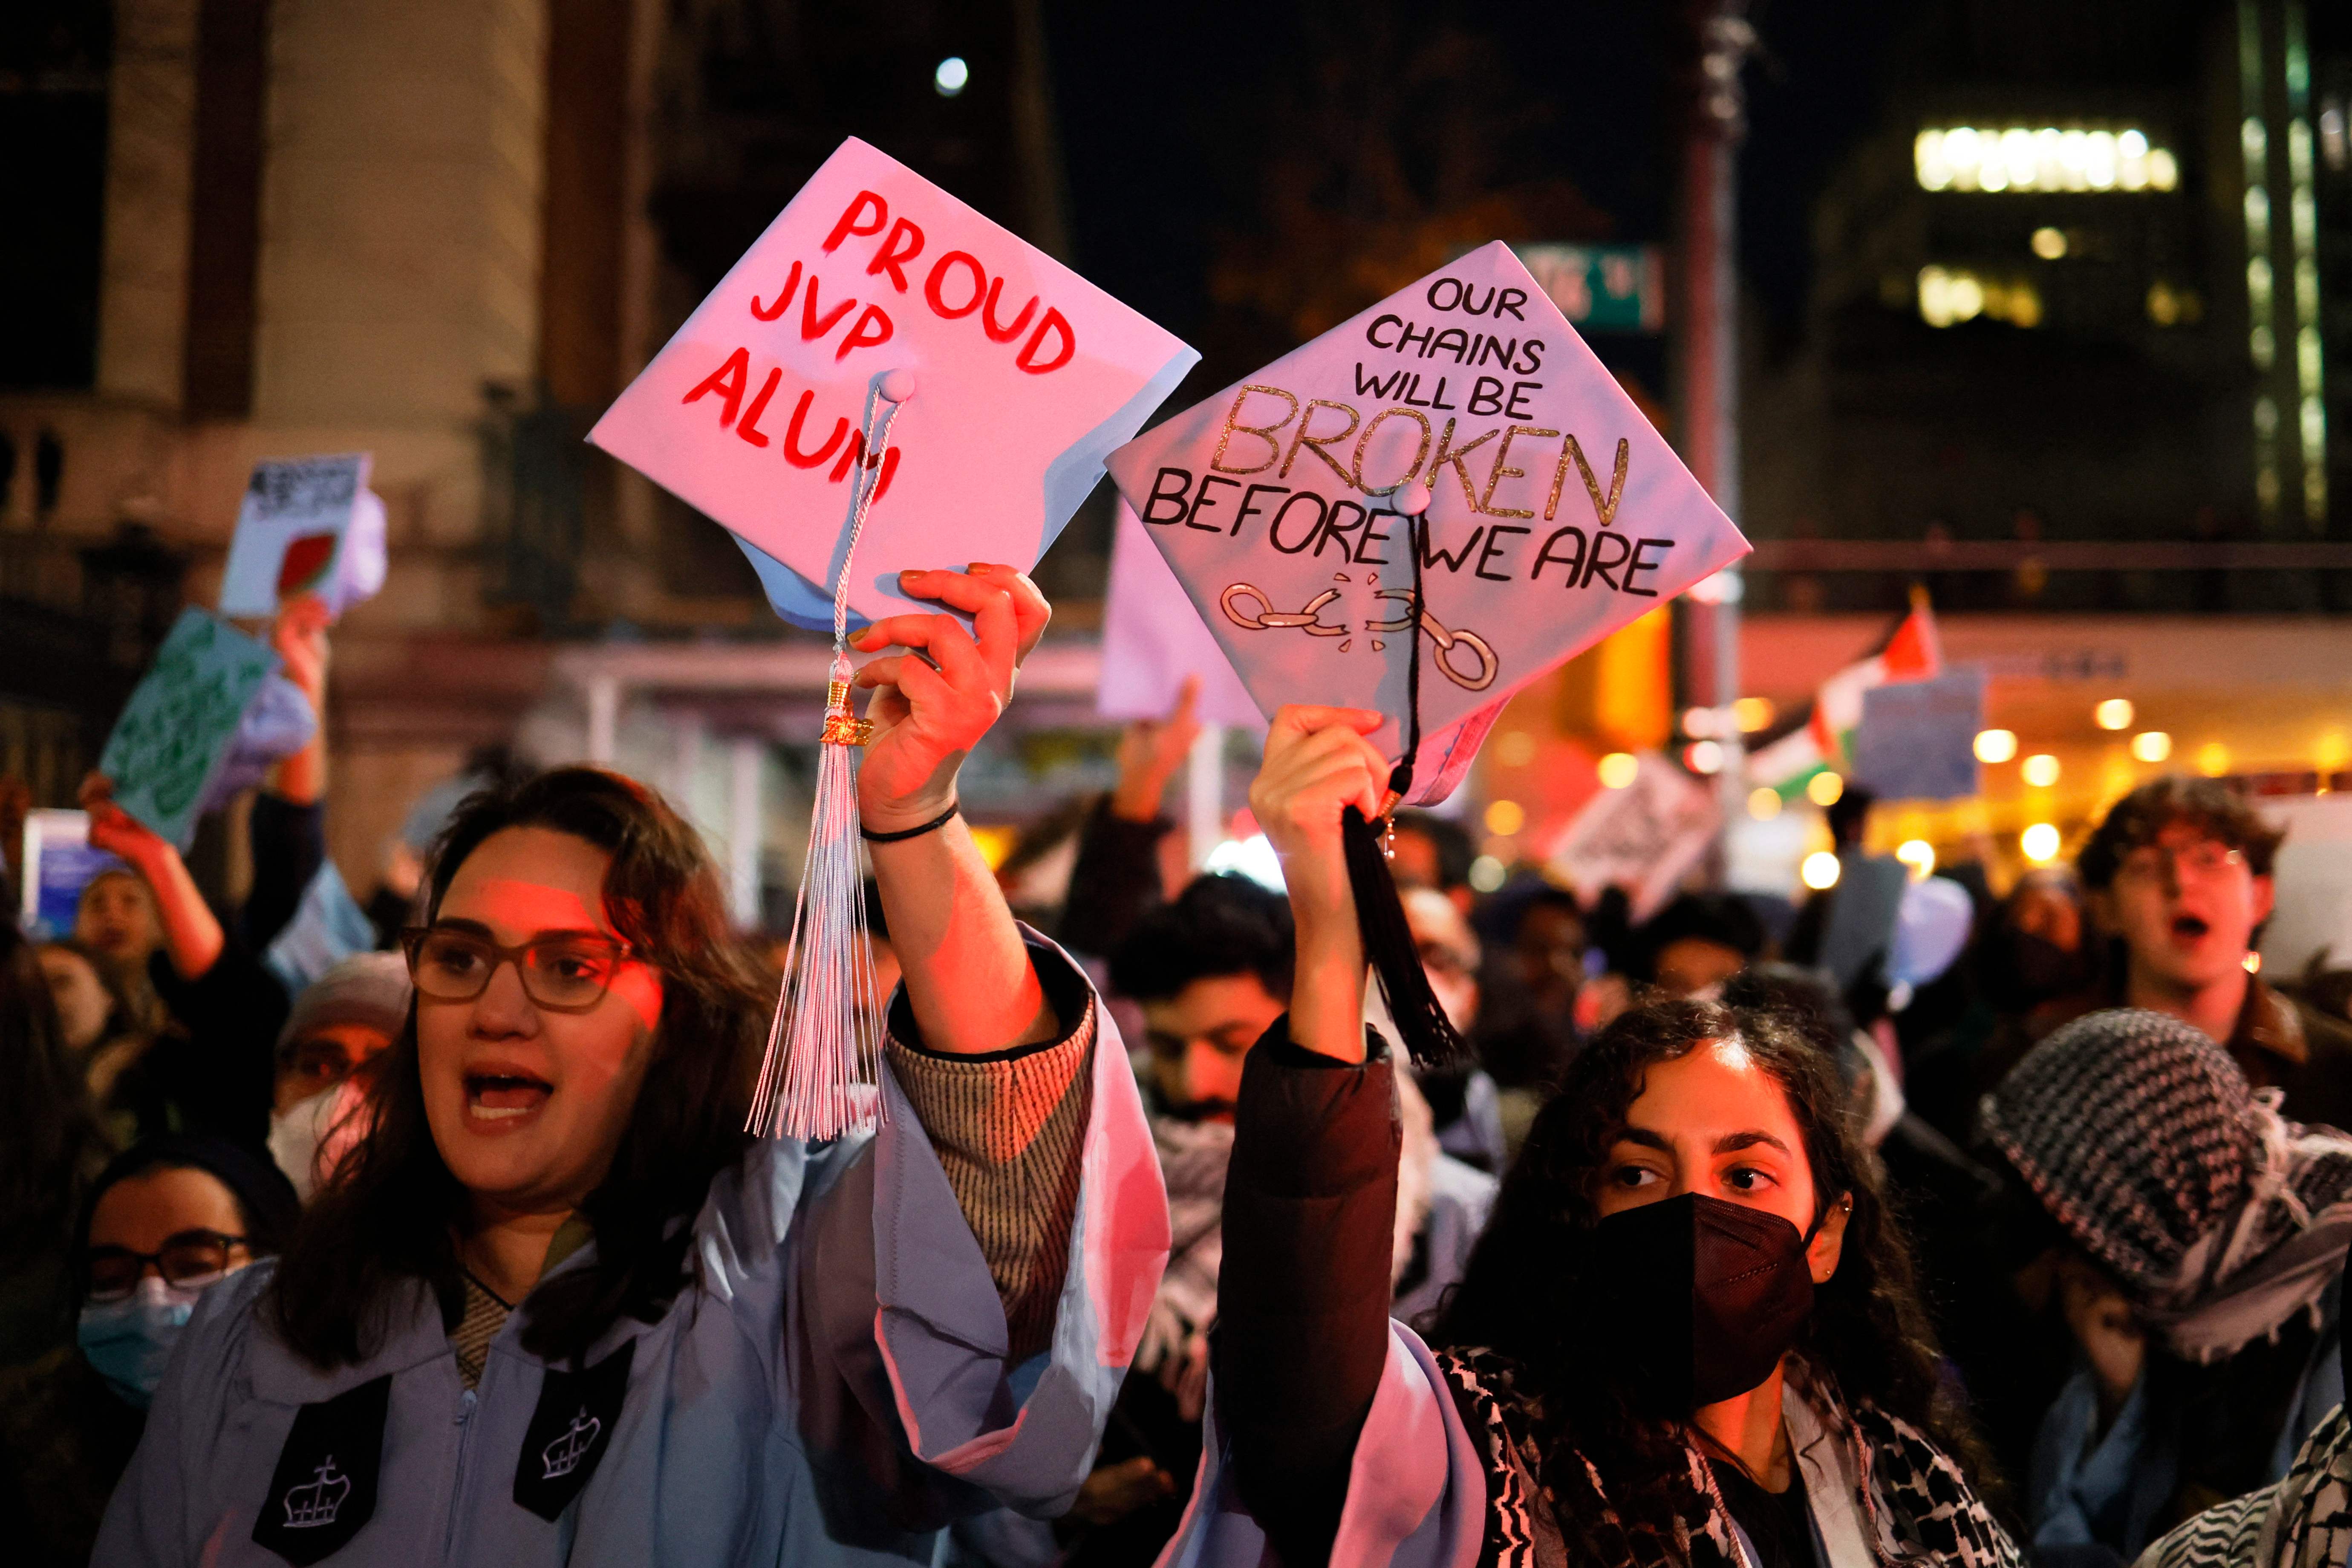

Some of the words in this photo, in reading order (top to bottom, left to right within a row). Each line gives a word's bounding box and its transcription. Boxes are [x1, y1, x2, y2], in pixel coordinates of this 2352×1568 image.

[750, 261, 893, 361] JVP
[823, 190, 1076, 374] PROUD
[1427, 278, 1527, 321] OUR
[1355, 362, 1456, 410] WILL
[1467, 377, 1543, 420] BE
[1366, 314, 1545, 375] CHAINS
[683, 348, 900, 505] ALUM
[1210, 385, 1628, 526] BROKEN
[1142, 467, 1401, 564] BEFORE
[1420, 517, 1531, 581] WE
[1531, 526, 1675, 597] ARE
